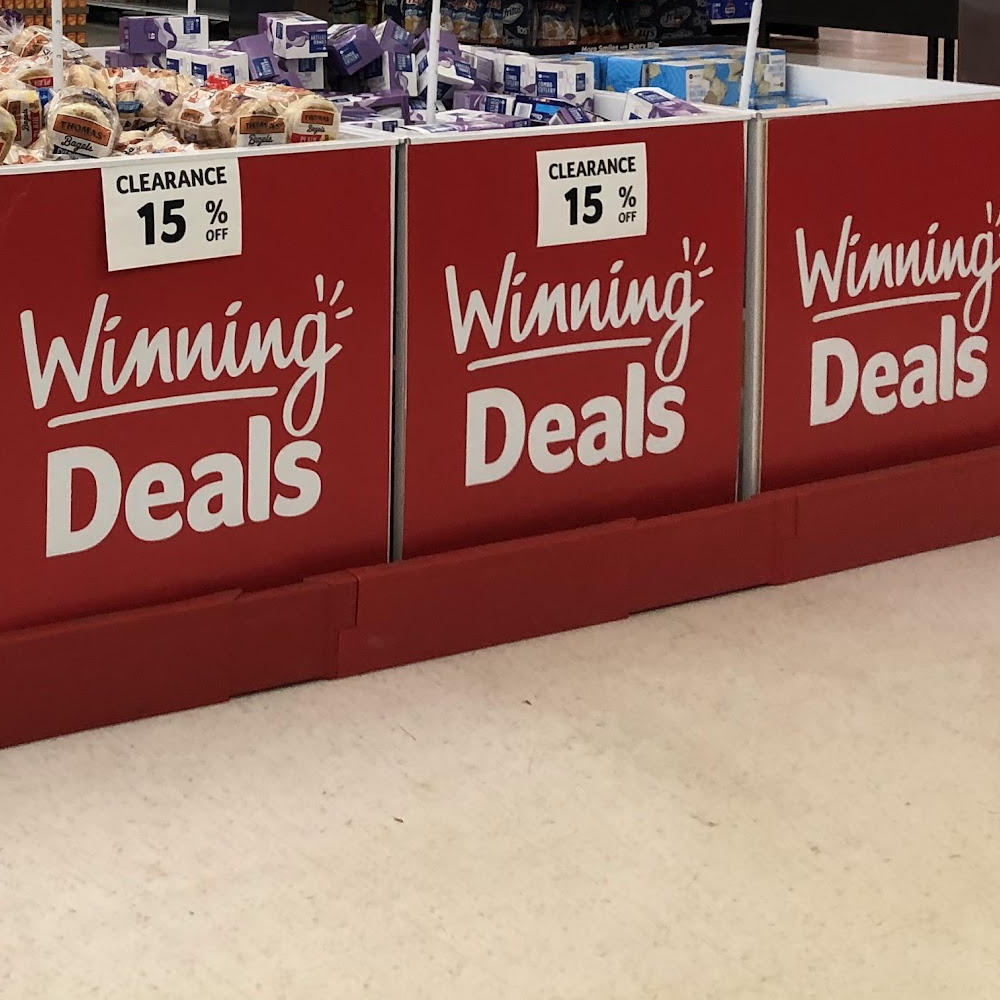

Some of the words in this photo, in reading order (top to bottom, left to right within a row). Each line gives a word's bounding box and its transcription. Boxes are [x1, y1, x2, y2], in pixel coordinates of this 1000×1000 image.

[60, 120, 103, 140] THOMAS
[246, 122, 280, 130] THOMAS
[248, 134, 273, 146] Bagels
[61, 136, 93, 152] Bagels
[116, 165, 228, 194] CLEARANCE
[549, 156, 636, 180] CLEARANCE
[137, 198, 187, 246] 15
[205, 199, 228, 224] %
[564, 184, 603, 226] 15
[618, 186, 637, 208] %
[618, 210, 637, 223] OFF
[206, 227, 229, 242] OFF
[796, 215, 1000, 333] Winning
[444, 251, 704, 382] Winning
[20, 293, 343, 437] Winning
[810, 314, 988, 427] Deals
[465, 362, 686, 486] Deals
[46, 415, 322, 557] Deals
